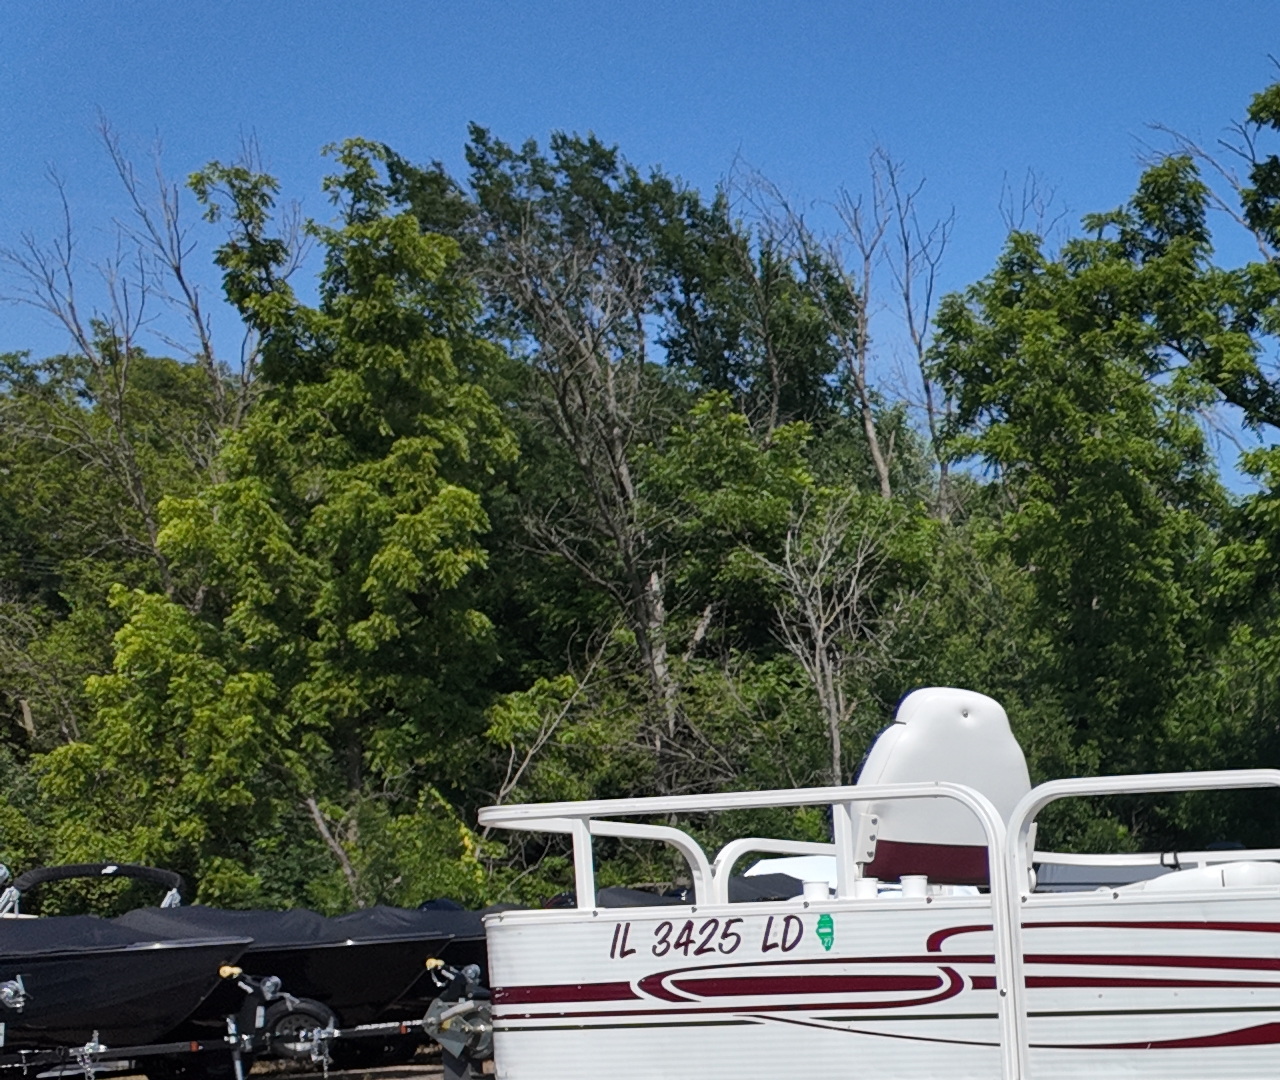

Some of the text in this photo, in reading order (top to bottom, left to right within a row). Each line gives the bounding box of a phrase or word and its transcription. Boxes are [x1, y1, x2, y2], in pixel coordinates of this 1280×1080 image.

[610, 914, 804, 960] IL 3425 LD
